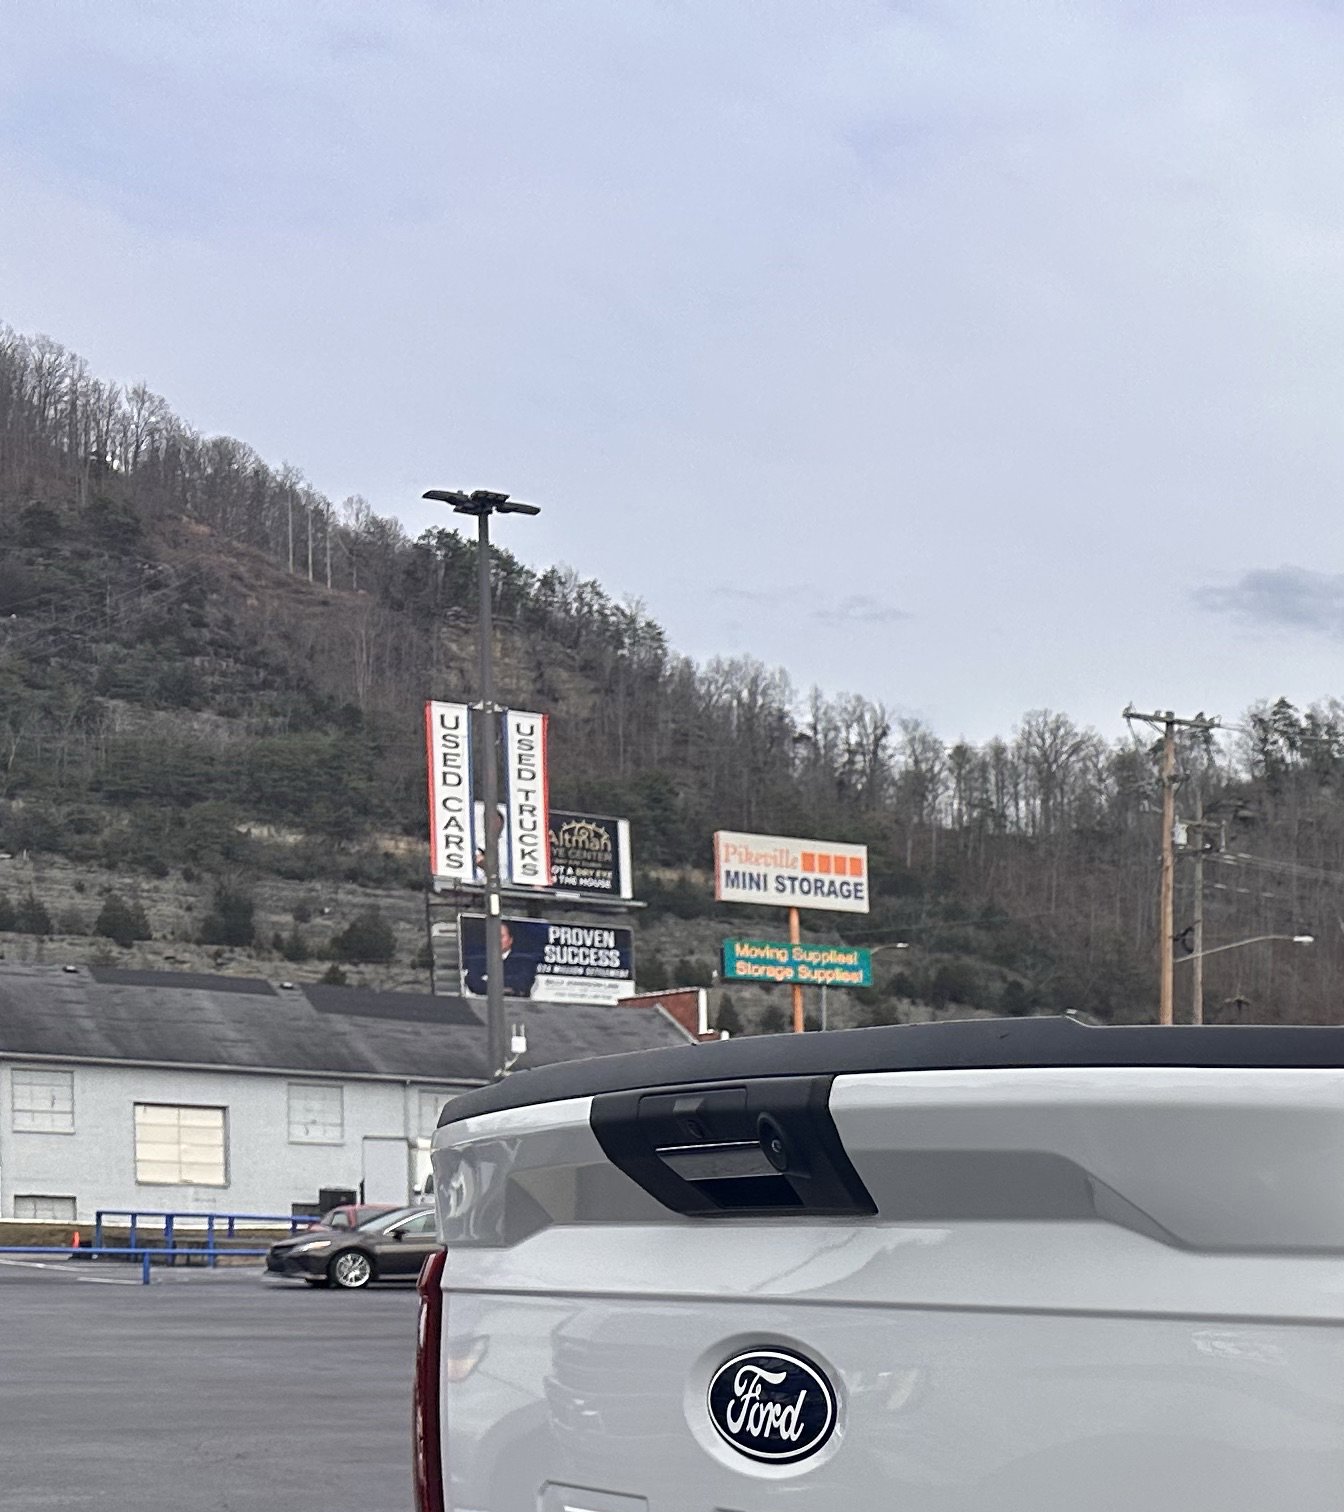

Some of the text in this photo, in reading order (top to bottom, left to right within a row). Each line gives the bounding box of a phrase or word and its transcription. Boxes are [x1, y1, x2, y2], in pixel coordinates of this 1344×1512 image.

[440, 714, 465, 869] USED CARS
[516, 723, 540, 877] USED TRUCKS
[723, 843, 799, 869] Pikeville
[725, 870, 865, 900] MINI STORAGE
[548, 926, 615, 948] PROVEN
[544, 944, 620, 967] SUCCESS
[735, 943, 858, 965] Moving Supplies!
[735, 961, 863, 984] Storage Supplies!
[726, 1365, 808, 1443] Ford
